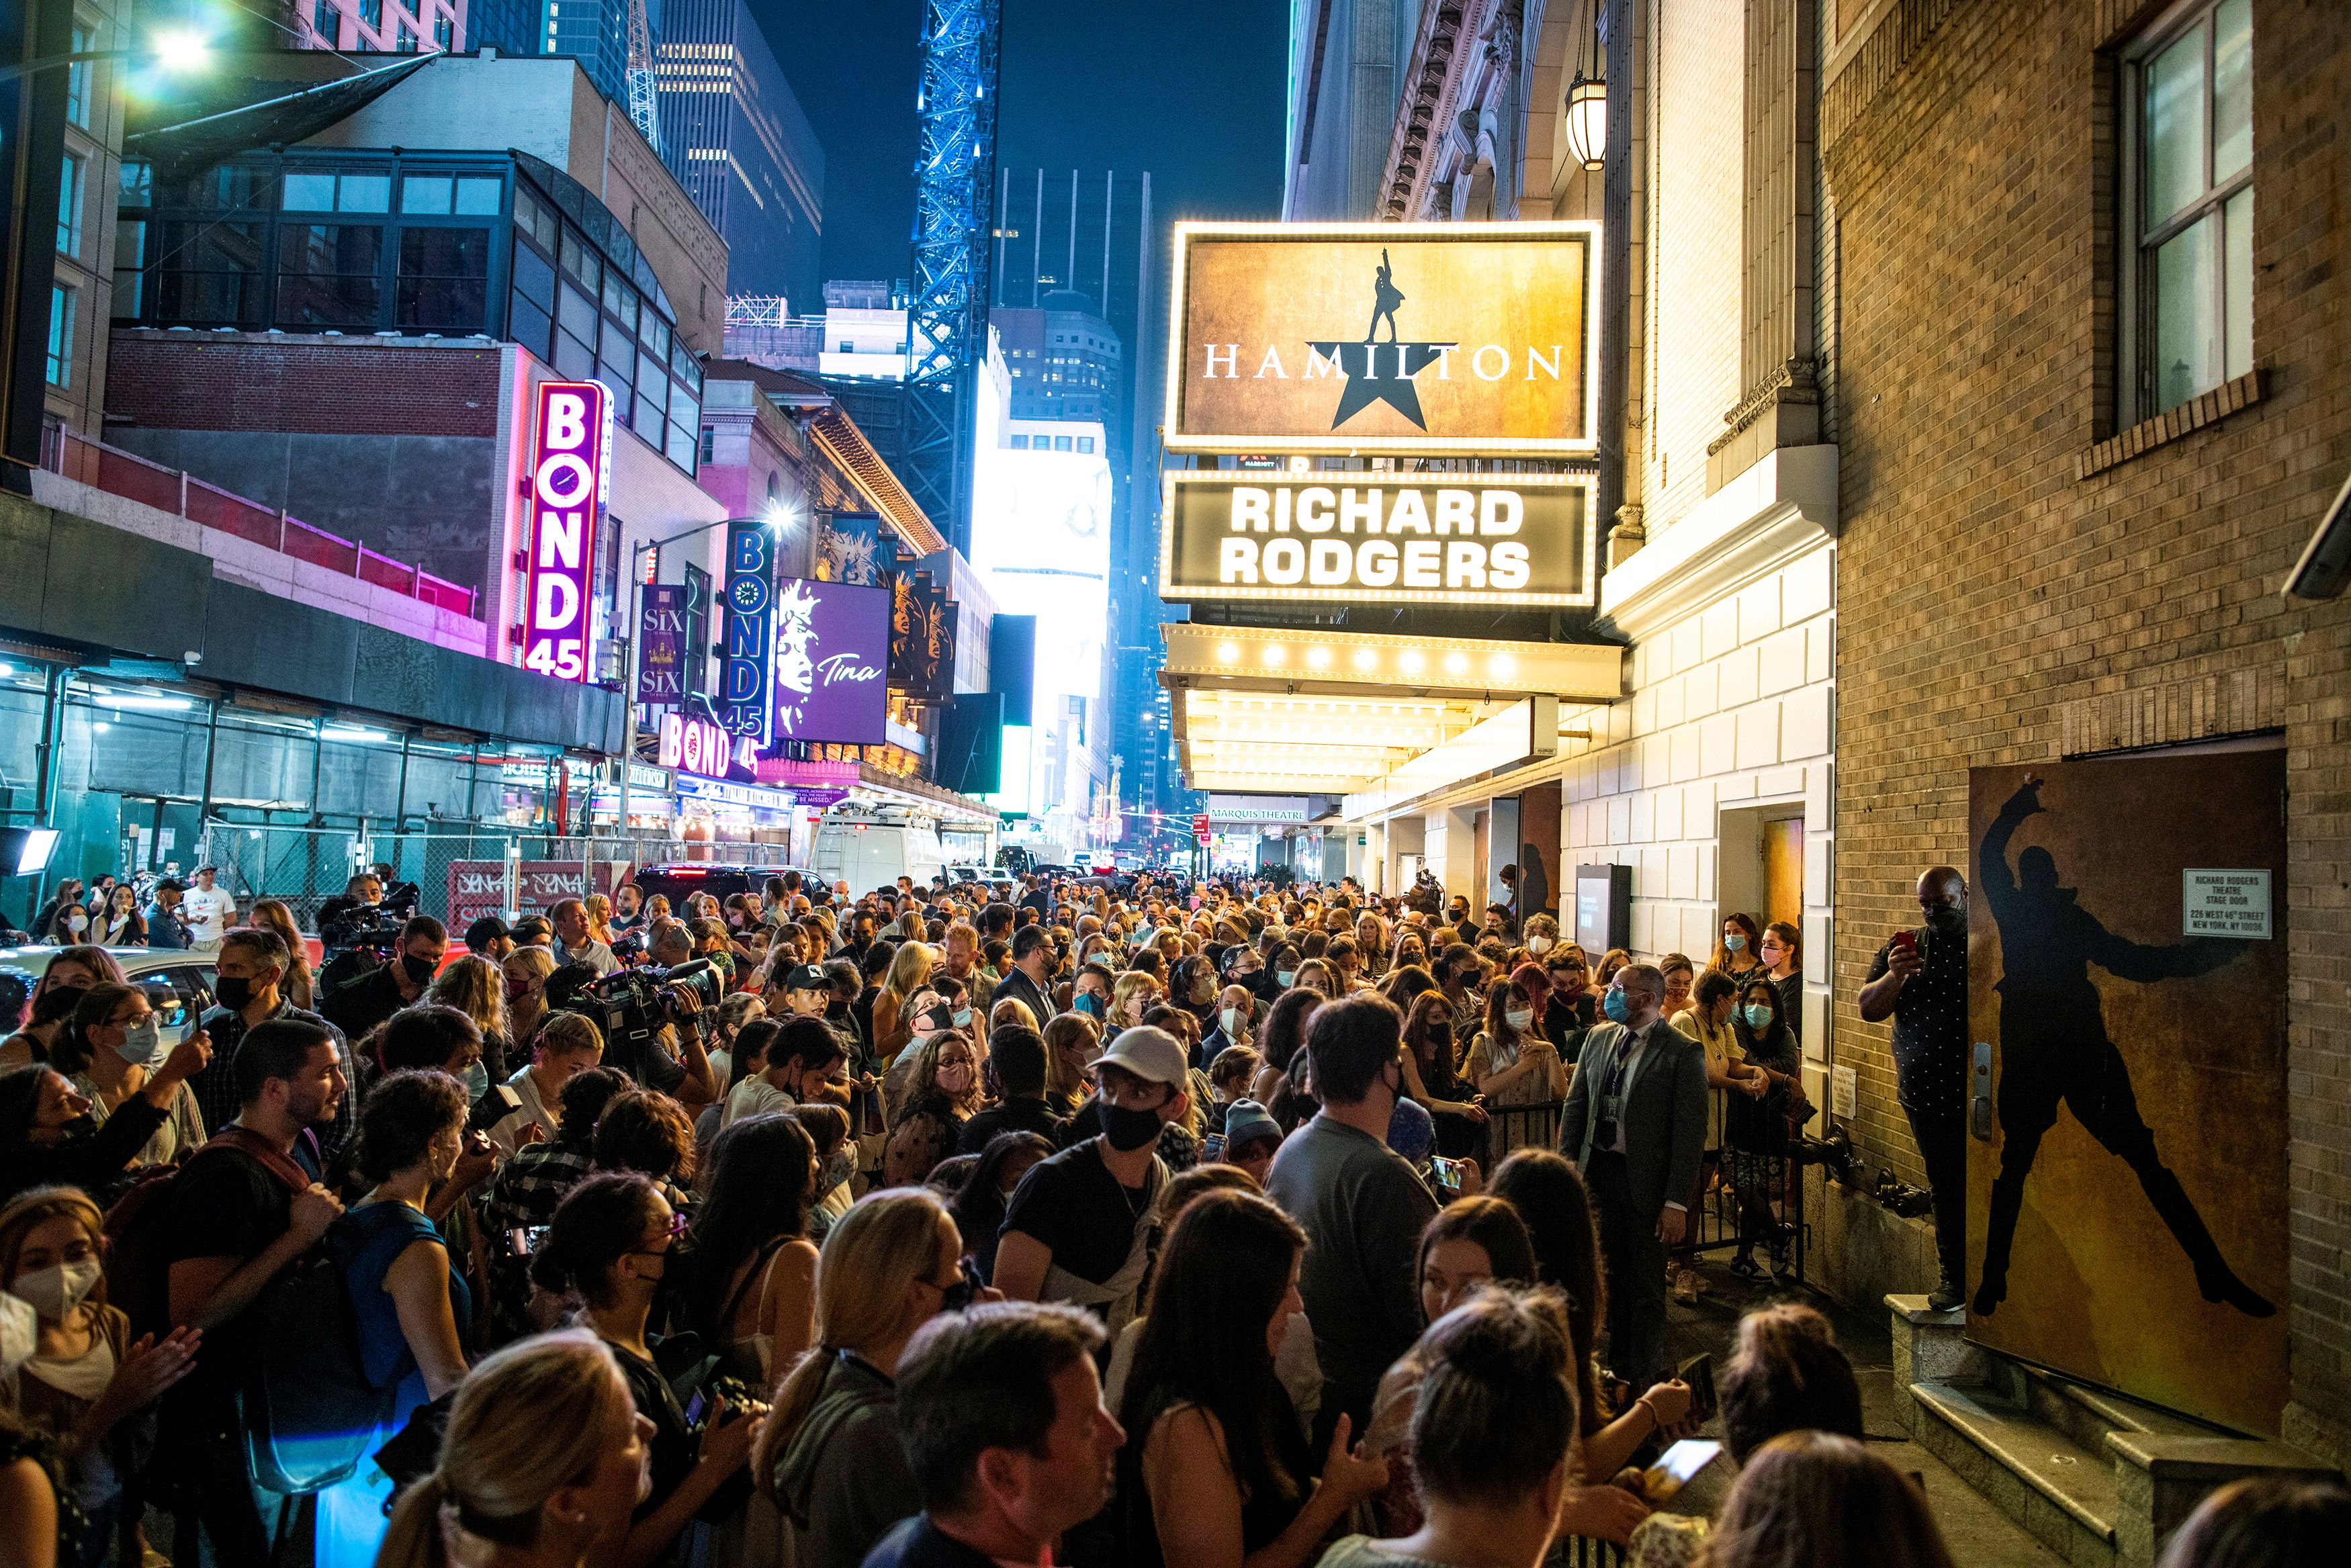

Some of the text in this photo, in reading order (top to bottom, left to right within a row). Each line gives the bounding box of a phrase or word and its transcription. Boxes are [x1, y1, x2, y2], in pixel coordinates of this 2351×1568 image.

[1203, 343, 1563, 381] HAMILTON
[1230, 487, 1525, 536] RICHARD
[525, 393, 592, 680] BOND 45
[1218, 537, 1532, 589] RODGERS
[723, 530, 768, 738] BOND 45
[817, 653, 882, 687] Tina
[668, 712, 759, 778] BOND 45
[1211, 809, 1305, 820] MARQUIS THEATRE
[2195, 876, 2259, 885] RICHARD RODGERS
[2212, 886, 2242, 894] THEATRE
[2205, 911, 2224, 919] WEST
[2238, 912, 2264, 921] STREET
[2206, 896, 2248, 905] STAGE DOOR
[2192, 921, 2207, 929] NEW
